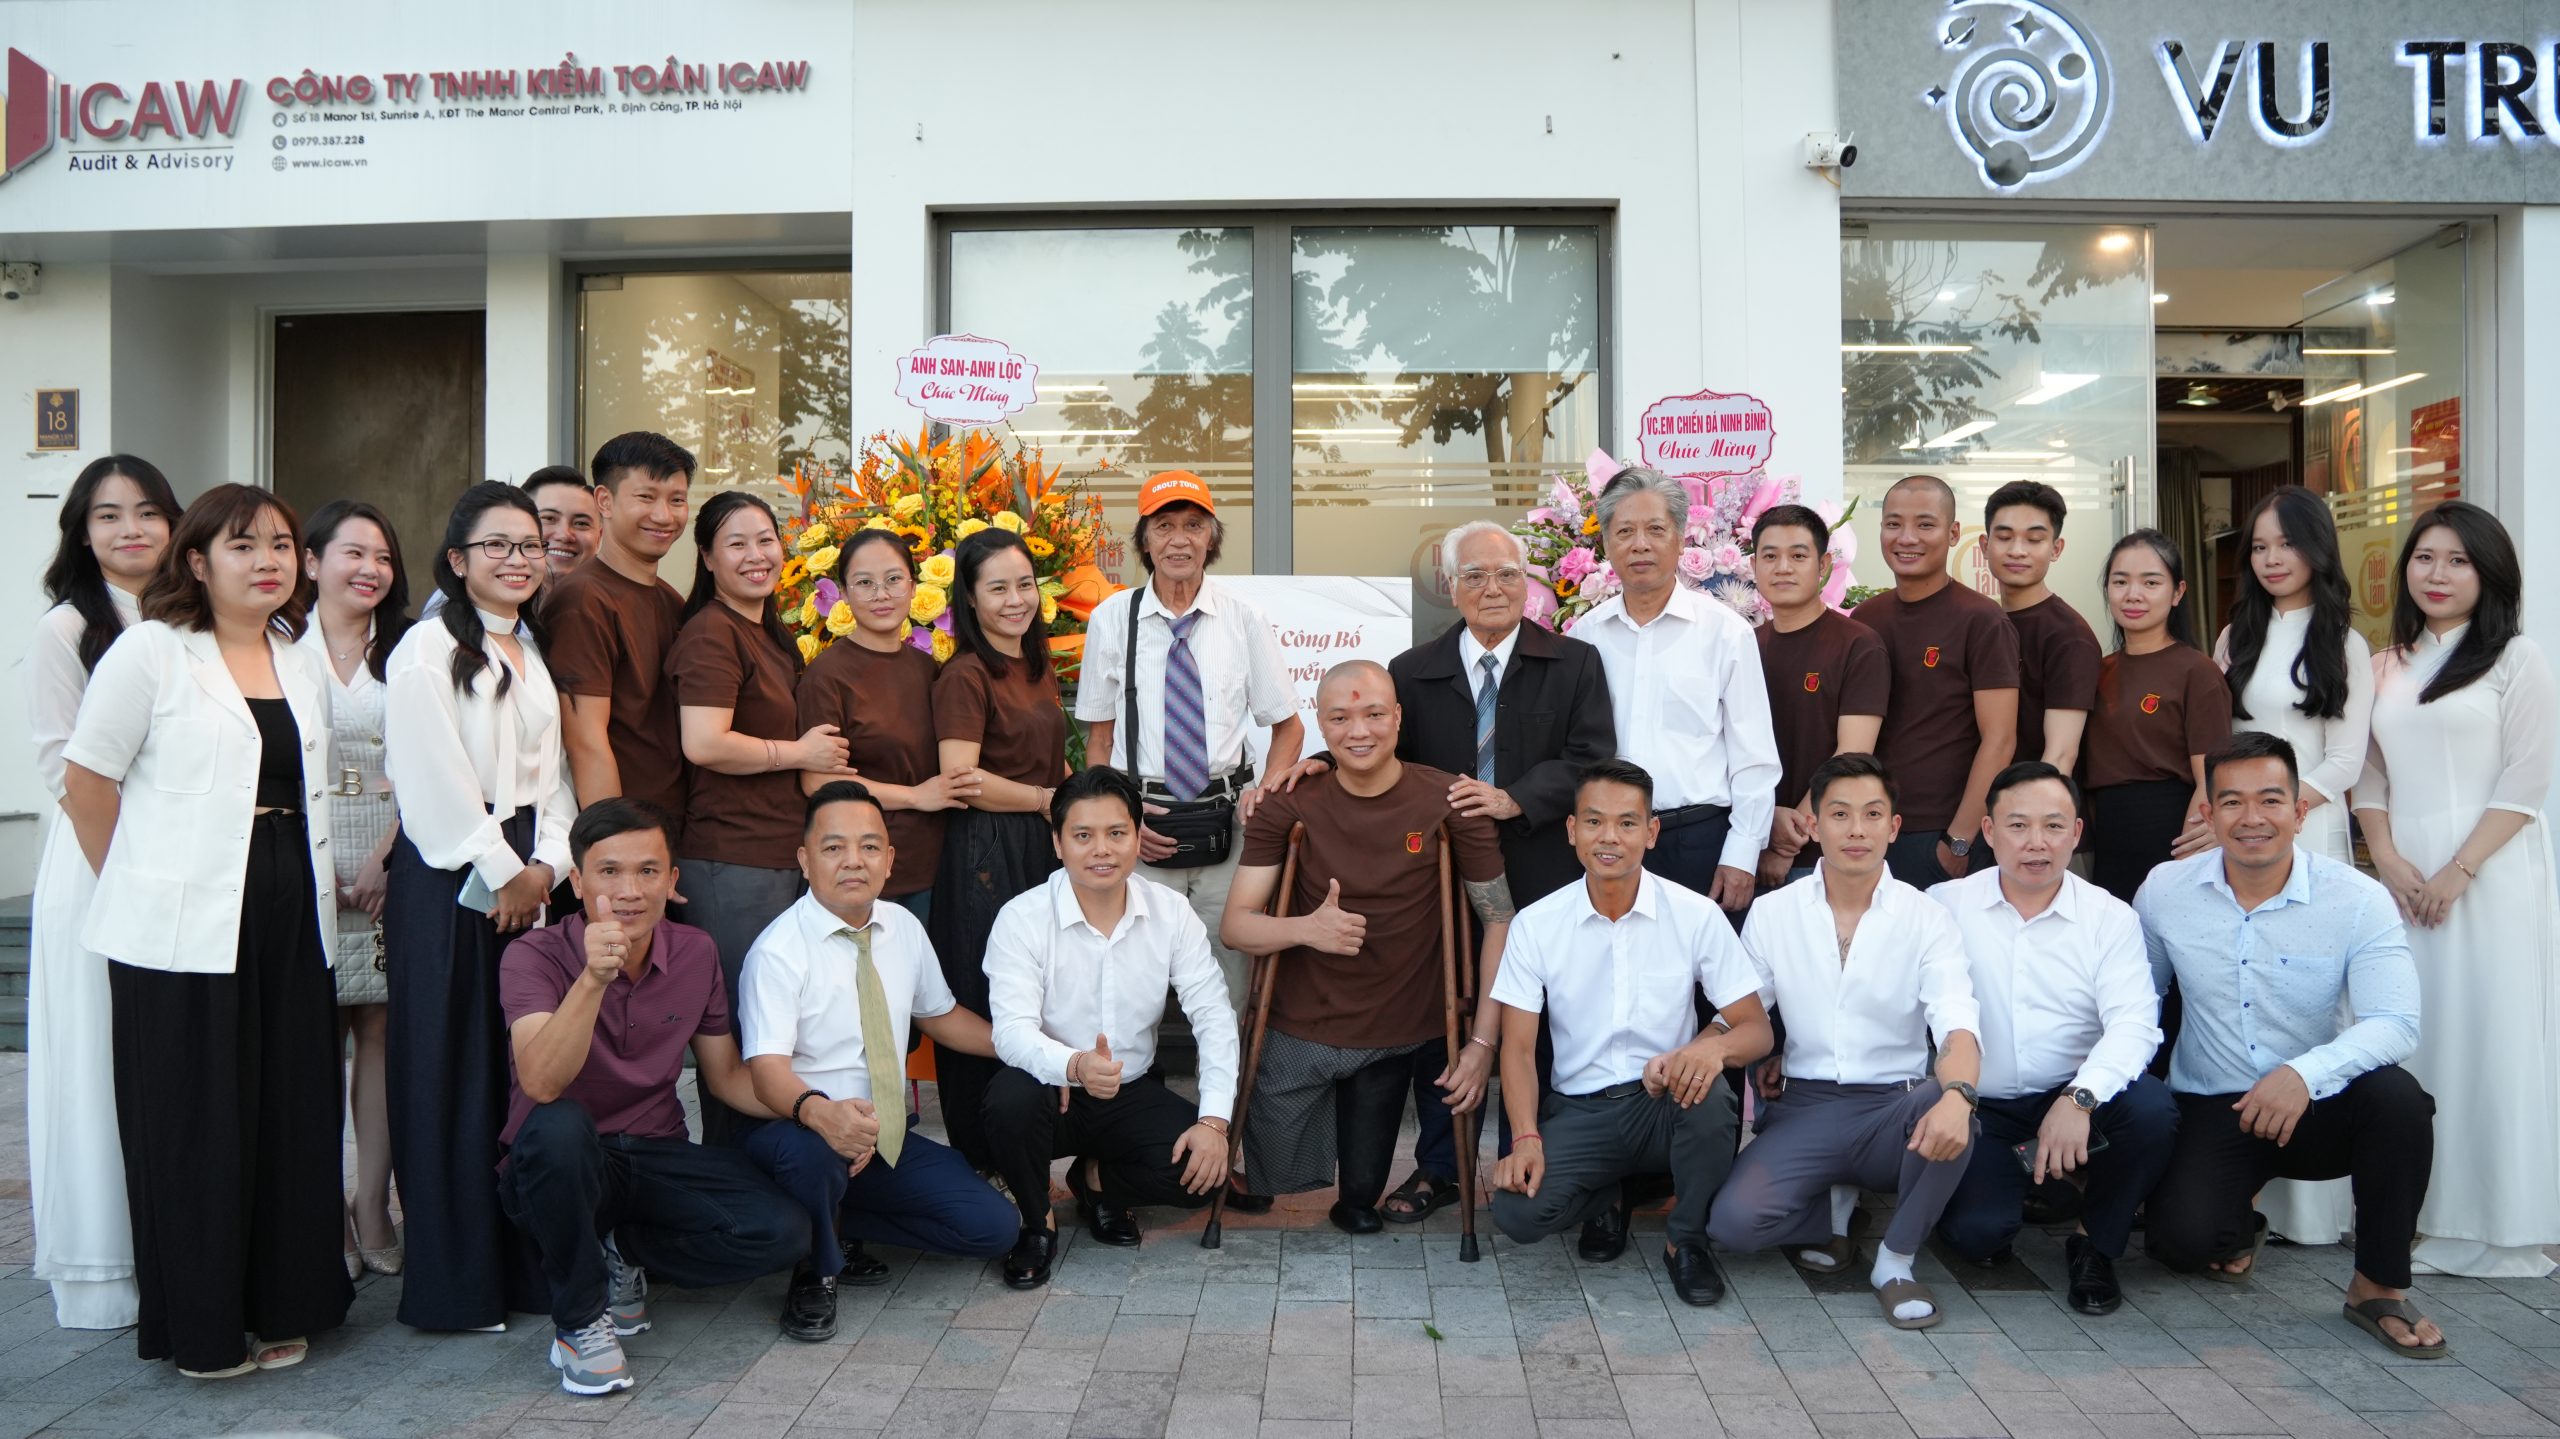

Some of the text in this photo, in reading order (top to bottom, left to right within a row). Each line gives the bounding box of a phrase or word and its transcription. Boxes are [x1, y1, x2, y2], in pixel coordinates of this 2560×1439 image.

[266, 51, 810, 106] CÔNG TY TNHH KIỂM TOÁN ICAW
[2161, 40, 2560, 141] VU TR
[60, 79, 244, 140] ICAW
[323, 112, 357, 122] Manor
[381, 109, 419, 120] Sunrise
[439, 107, 460, 118] KĐT
[465, 107, 484, 118] The
[489, 106, 525, 118] Manor
[529, 104, 570, 116] Central
[574, 103, 604, 115] Park,
[621, 103, 646, 115] Định
[723, 99, 742, 112] Nội
[292, 135, 365, 147] 0979.387.228
[68, 152, 235, 172] Audit & Advisory
[292, 157, 368, 168] www.icaw.vn
[911, 356, 1022, 383] ANH SAN-ANH LỘC
[920, 381, 1010, 410] Chúc Mừng
[47, 411, 68, 431] 18
[1647, 415, 1675, 436] VC.EM
[1677, 408, 1703, 435] CHIẾN
[1720, 413, 1742, 432] NINH
[1658, 438, 1757, 461] Chúc Mừng
[1152, 480, 1178, 493] GROUP
[1280, 629, 1331, 653] Công
[1334, 624, 1364, 648] Bố
